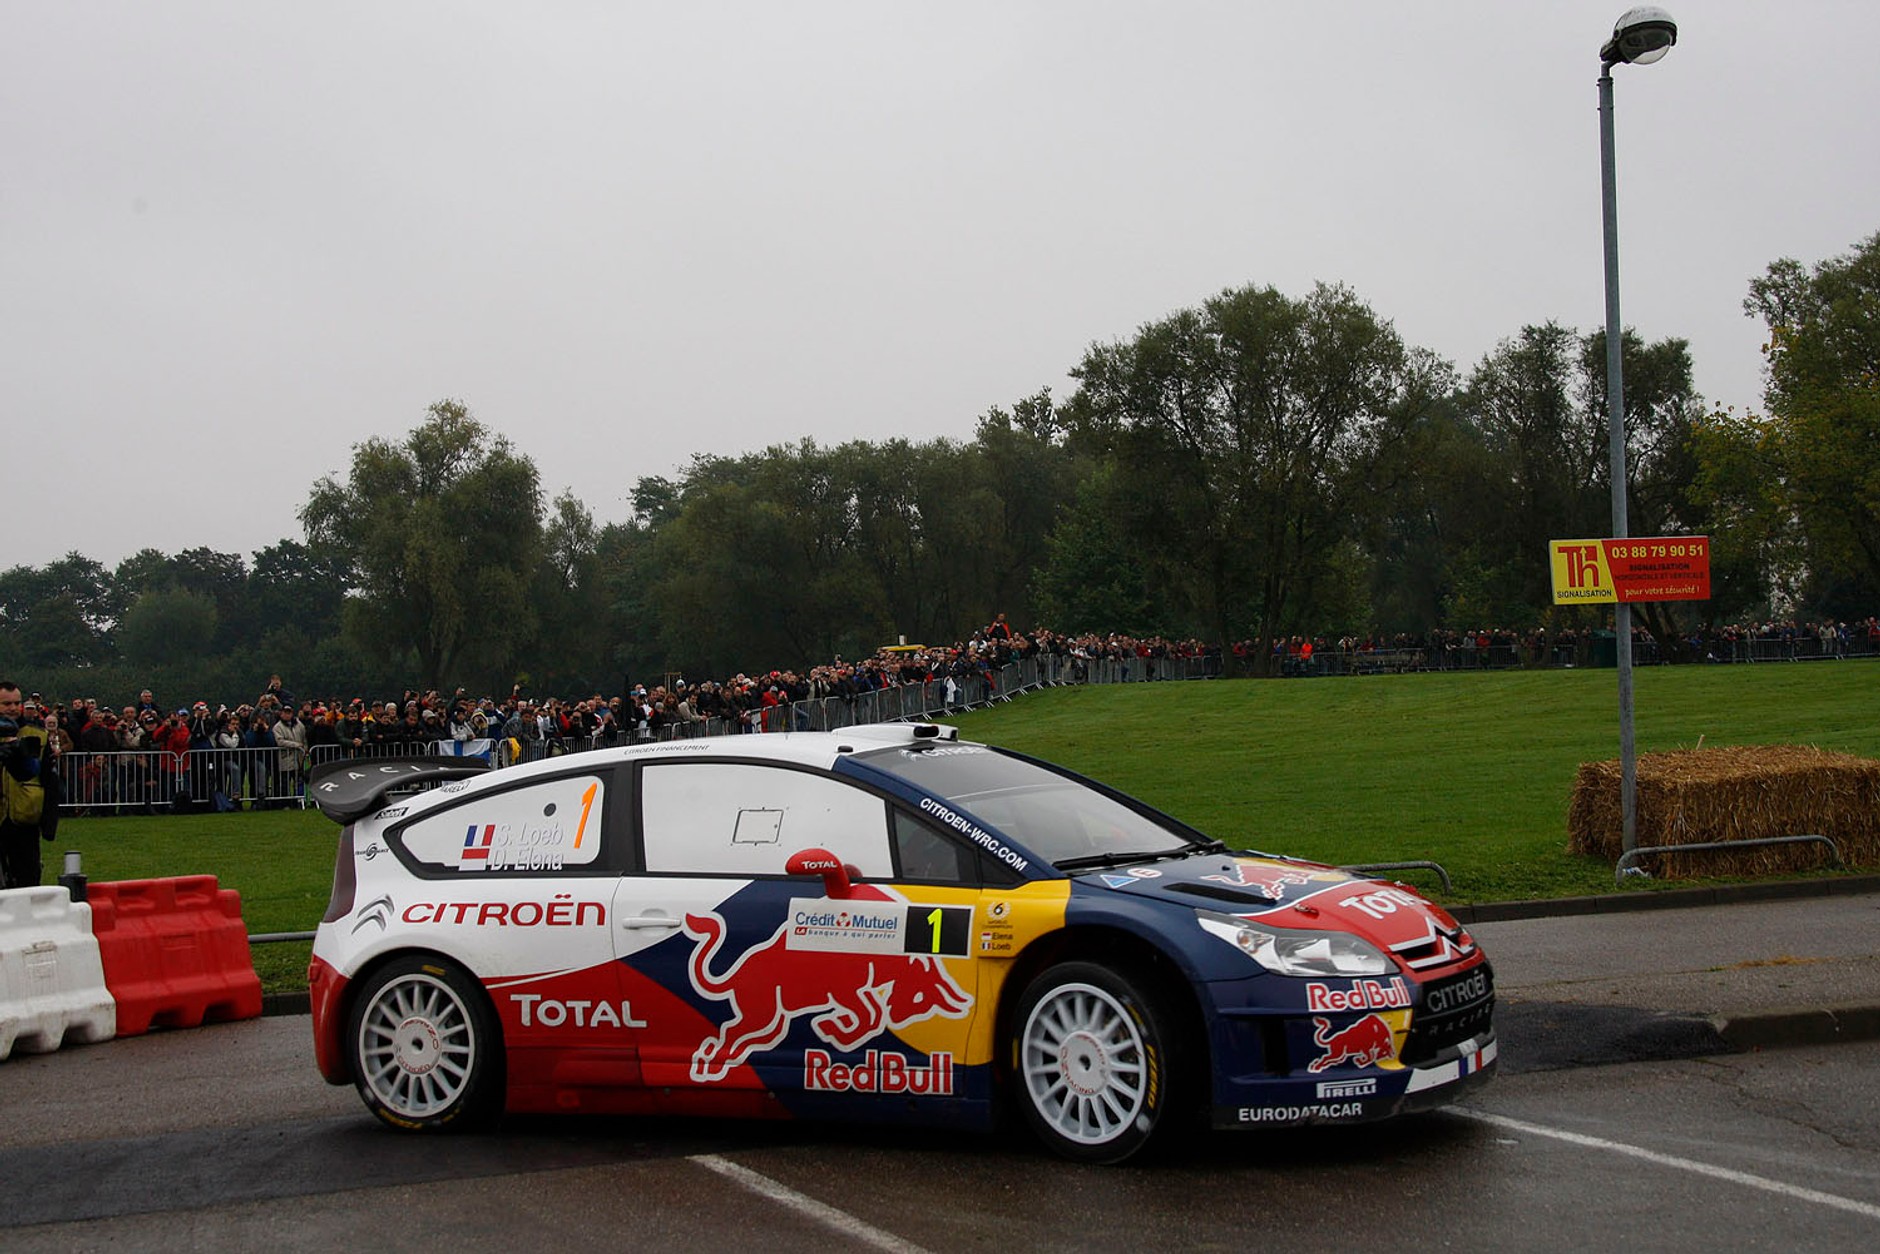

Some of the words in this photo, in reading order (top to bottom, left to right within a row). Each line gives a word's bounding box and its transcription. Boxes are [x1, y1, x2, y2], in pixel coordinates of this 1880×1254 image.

[1612, 547, 1628, 558] 03
[1631, 546, 1647, 558] 88
[1651, 545, 1666, 557] 79
[1670, 545, 1685, 557] 90
[1689, 544, 1704, 556] 51
[1557, 589, 1612, 598] SIGNALISATION
[1625, 588, 1643, 599] pour
[1645, 586, 1663, 595] votre
[1665, 584, 1695, 594] sécurité
[574, 782, 597, 849] 1
[518, 822, 564, 847] Loeb
[920, 798, 1028, 871] CITROEN-WRC.COM
[491, 849, 508, 871] D.
[514, 847, 564, 871] Elena
[801, 860, 838, 870] TOTAL
[402, 894, 606, 927] CITROËN
[993, 903, 1003, 916] 6
[795, 912, 835, 927] Crédit
[852, 915, 898, 930] Mutuel
[927, 908, 943, 953] 1
[808, 929, 839, 937] banque
[992, 932, 1013, 940] Elena
[1306, 980, 1368, 1012] Red
[1363, 977, 1412, 1008] Bull
[510, 994, 647, 1028] TOTAL
[805, 1048, 877, 1092] Red
[880, 1051, 953, 1095] Bull
[1316, 1078, 1377, 1098] PIRELLI
[1238, 1102, 1362, 1121] EURODATACAR
